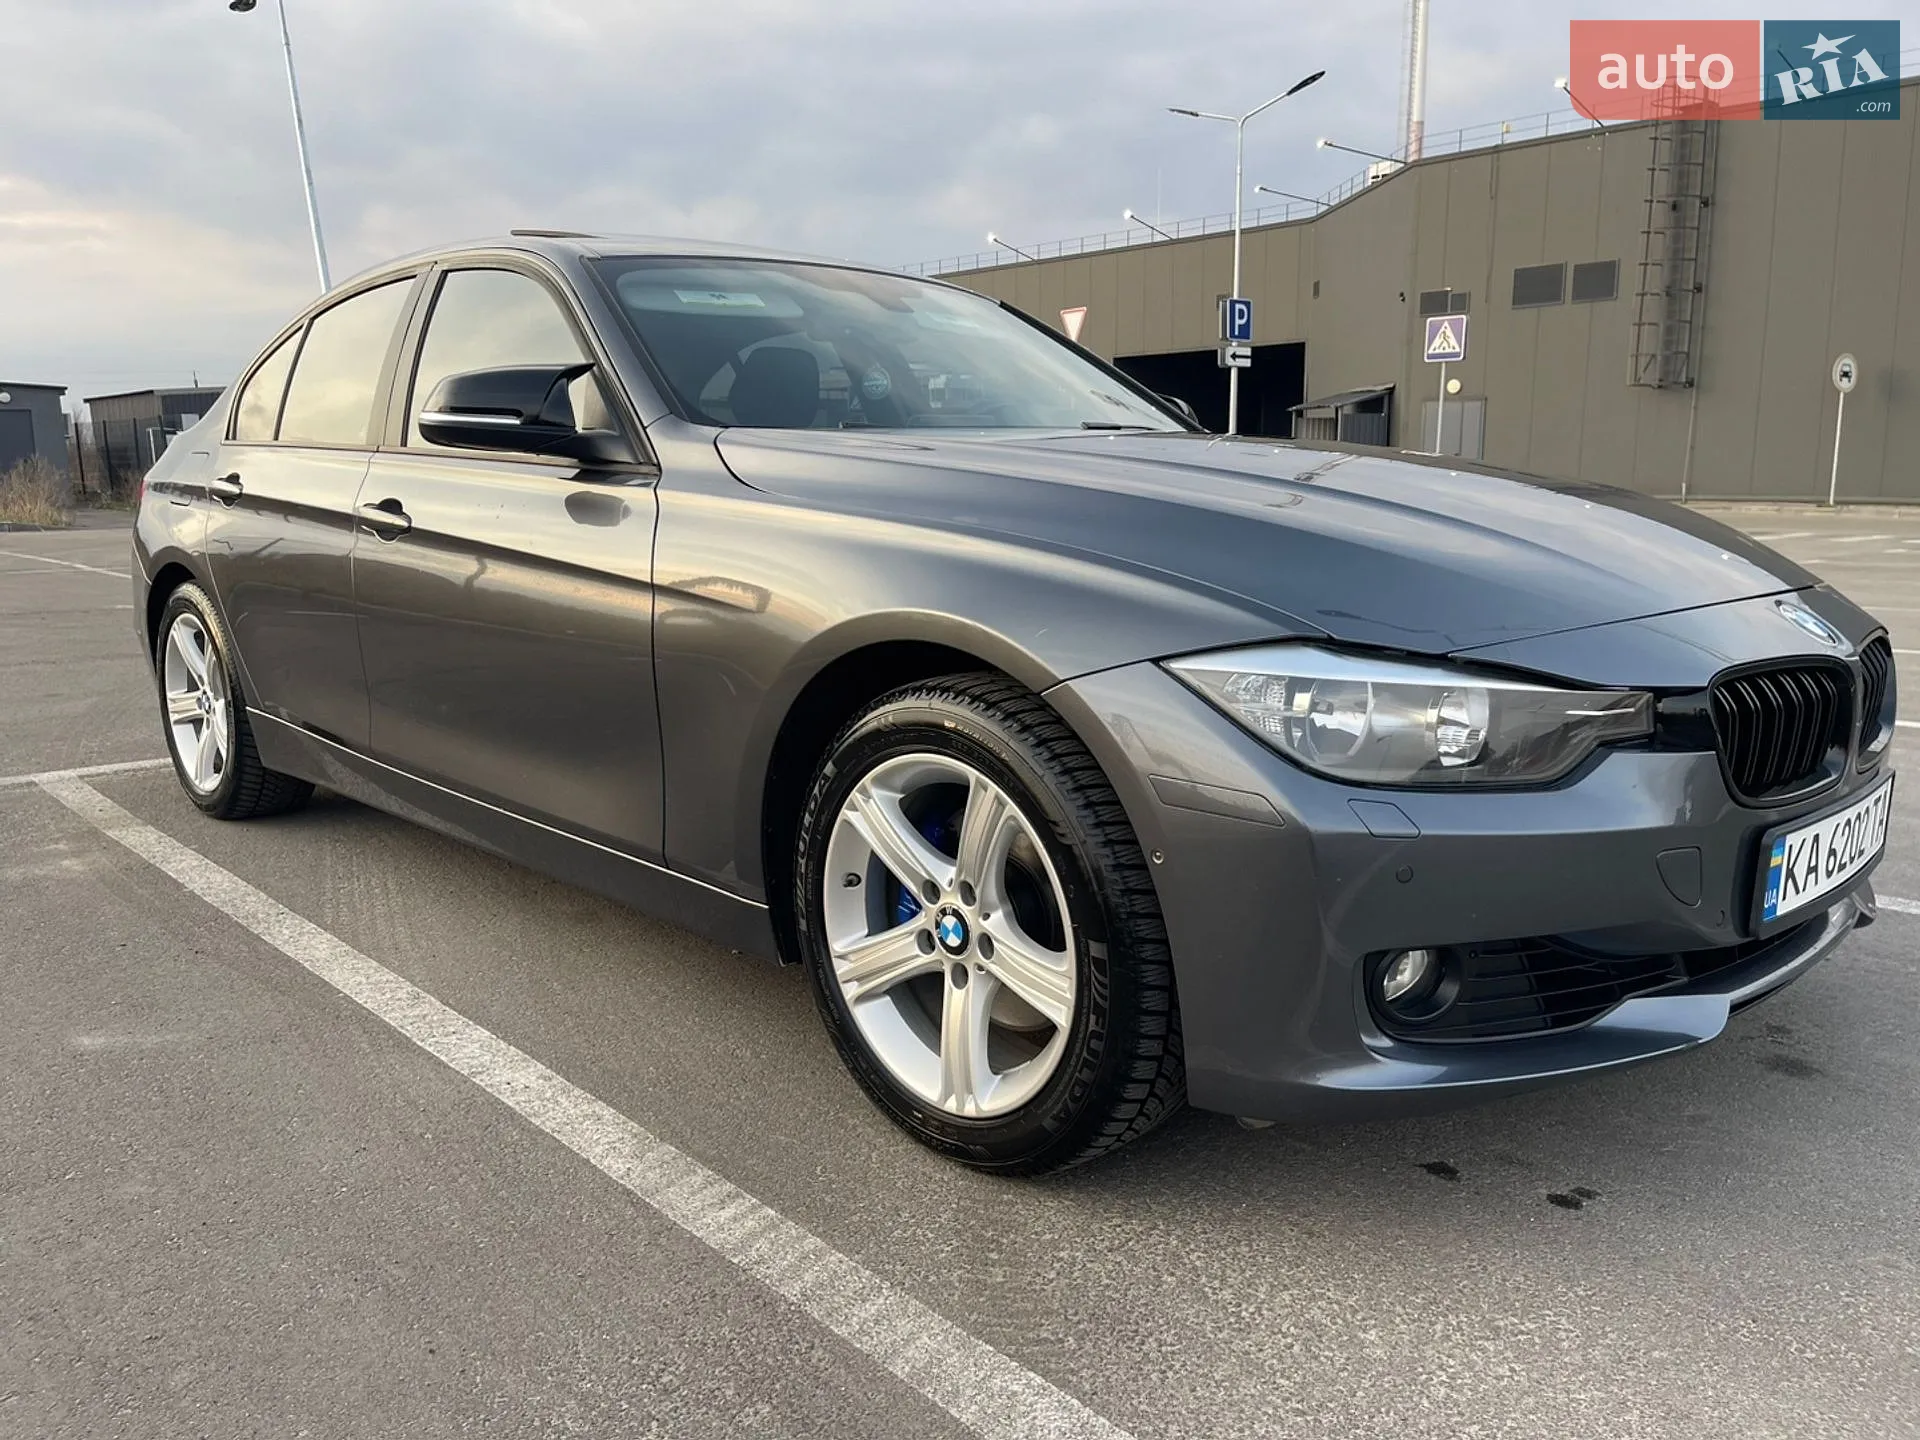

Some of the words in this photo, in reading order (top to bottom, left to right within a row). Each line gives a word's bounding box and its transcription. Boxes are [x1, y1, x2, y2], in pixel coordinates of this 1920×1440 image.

[1234, 303, 1248, 336] P
[1782, 832, 1820, 902] KA
[1825, 805, 1870, 880] 6202
[1763, 887, 1778, 909] UA
[1050, 1002, 1106, 1123] FULDA
